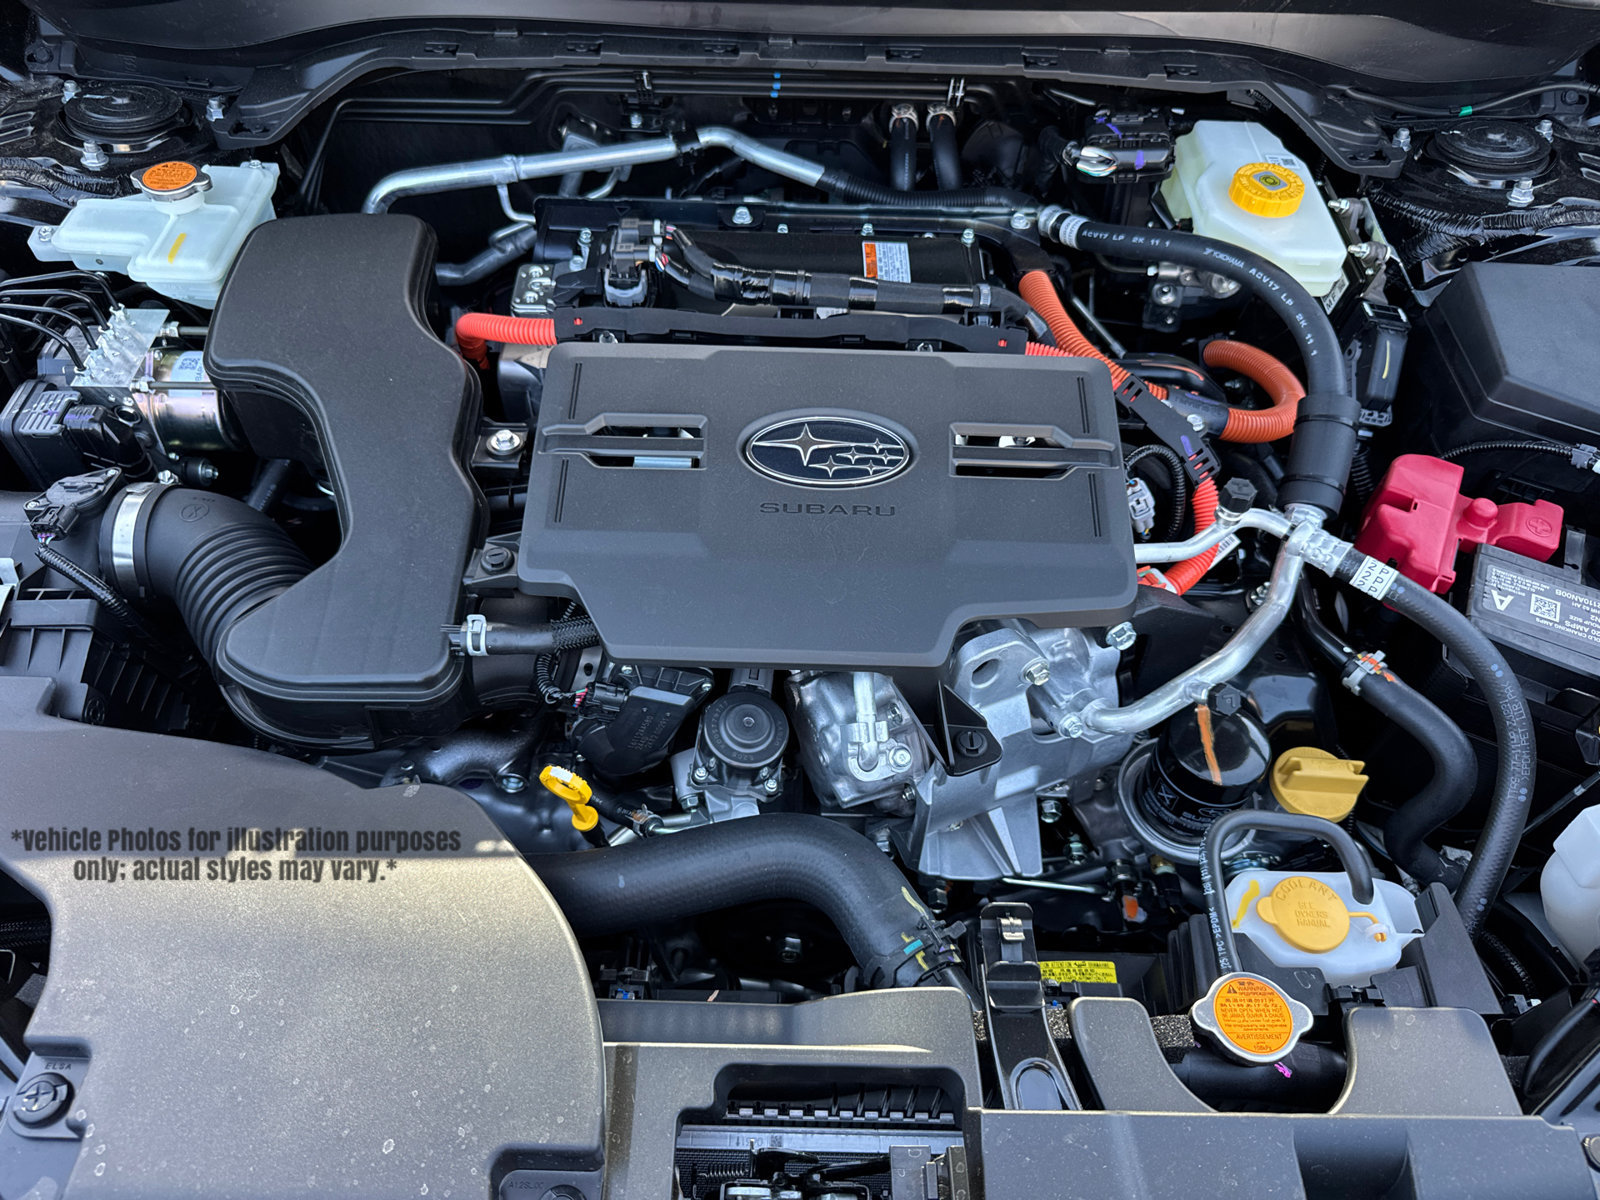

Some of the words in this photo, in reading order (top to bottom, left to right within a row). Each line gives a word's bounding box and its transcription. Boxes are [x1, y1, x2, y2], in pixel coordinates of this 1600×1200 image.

[760, 502, 896, 516] SUBARU
[1491, 590, 1514, 611] A
[1554, 623, 1587, 638] CRANKING
[1564, 620, 1590, 632] AMPS
[1276, 879, 1338, 902] COOLANT
